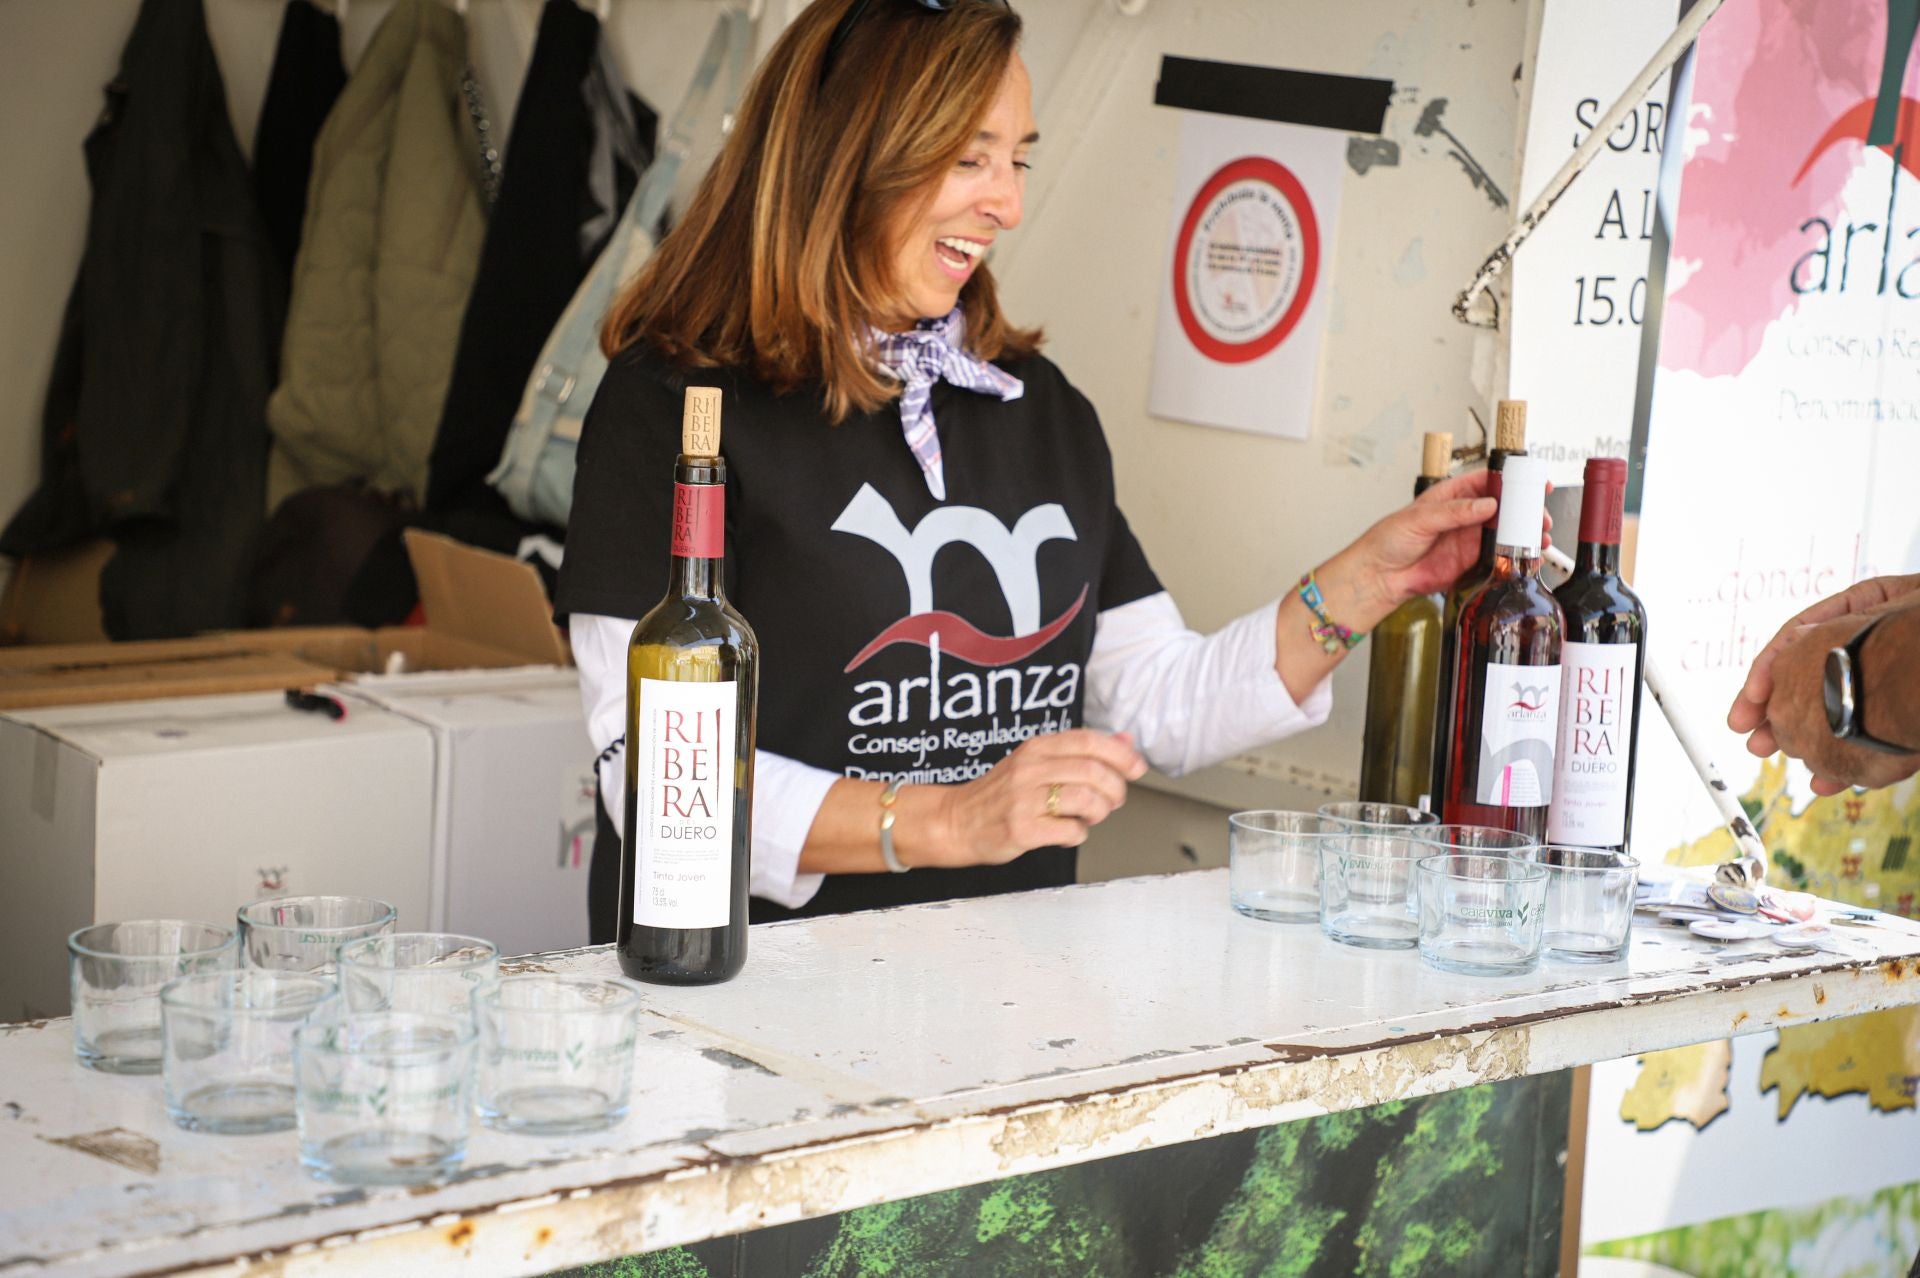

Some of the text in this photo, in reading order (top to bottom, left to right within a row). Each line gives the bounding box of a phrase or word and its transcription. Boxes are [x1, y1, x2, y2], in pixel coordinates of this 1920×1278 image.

[848, 631, 1081, 726] arlanza
[1577, 667, 1609, 695] RI
[1576, 698, 1613, 725] BE
[664, 709, 705, 744] RI
[848, 730, 939, 767] Consejo
[943, 714, 1040, 756] Regulador
[1574, 728, 1613, 756] RA
[663, 747, 708, 781] BE
[1571, 760, 1617, 774] DUERO
[662, 785, 713, 818] RA
[661, 825, 717, 840] DUERO
[1460, 905, 1513, 920] cajaviva
